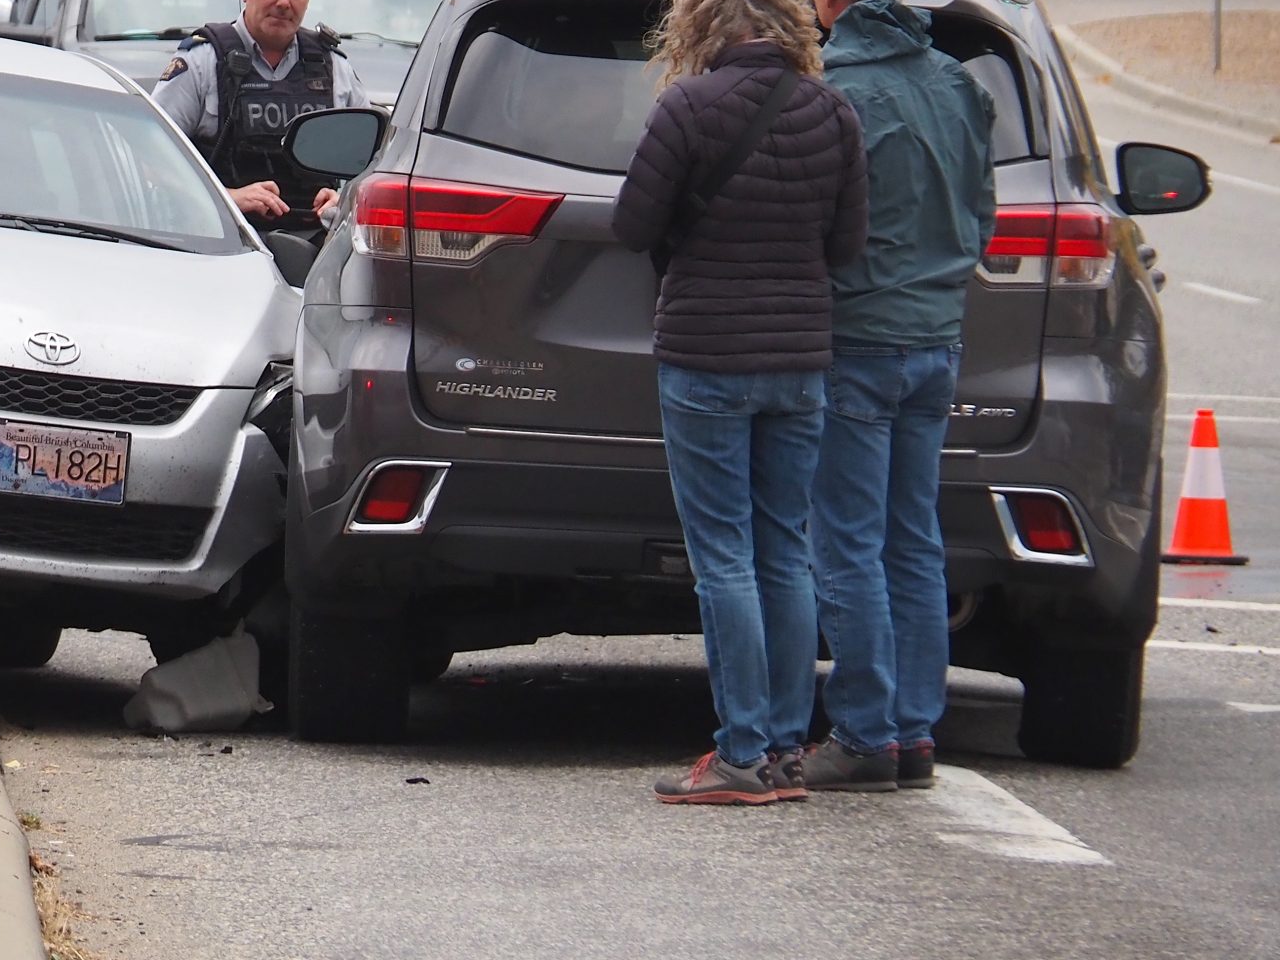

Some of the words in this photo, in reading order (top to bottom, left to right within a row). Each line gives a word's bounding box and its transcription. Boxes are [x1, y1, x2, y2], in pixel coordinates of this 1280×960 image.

[435, 381, 557, 402] HIGHLANDER
[977, 407, 1017, 418] AWD
[5, 431, 43, 444] Beautiful
[44, 436, 74, 448] British
[75, 439, 115, 452] Columbia
[13, 444, 122, 484] PL182H
